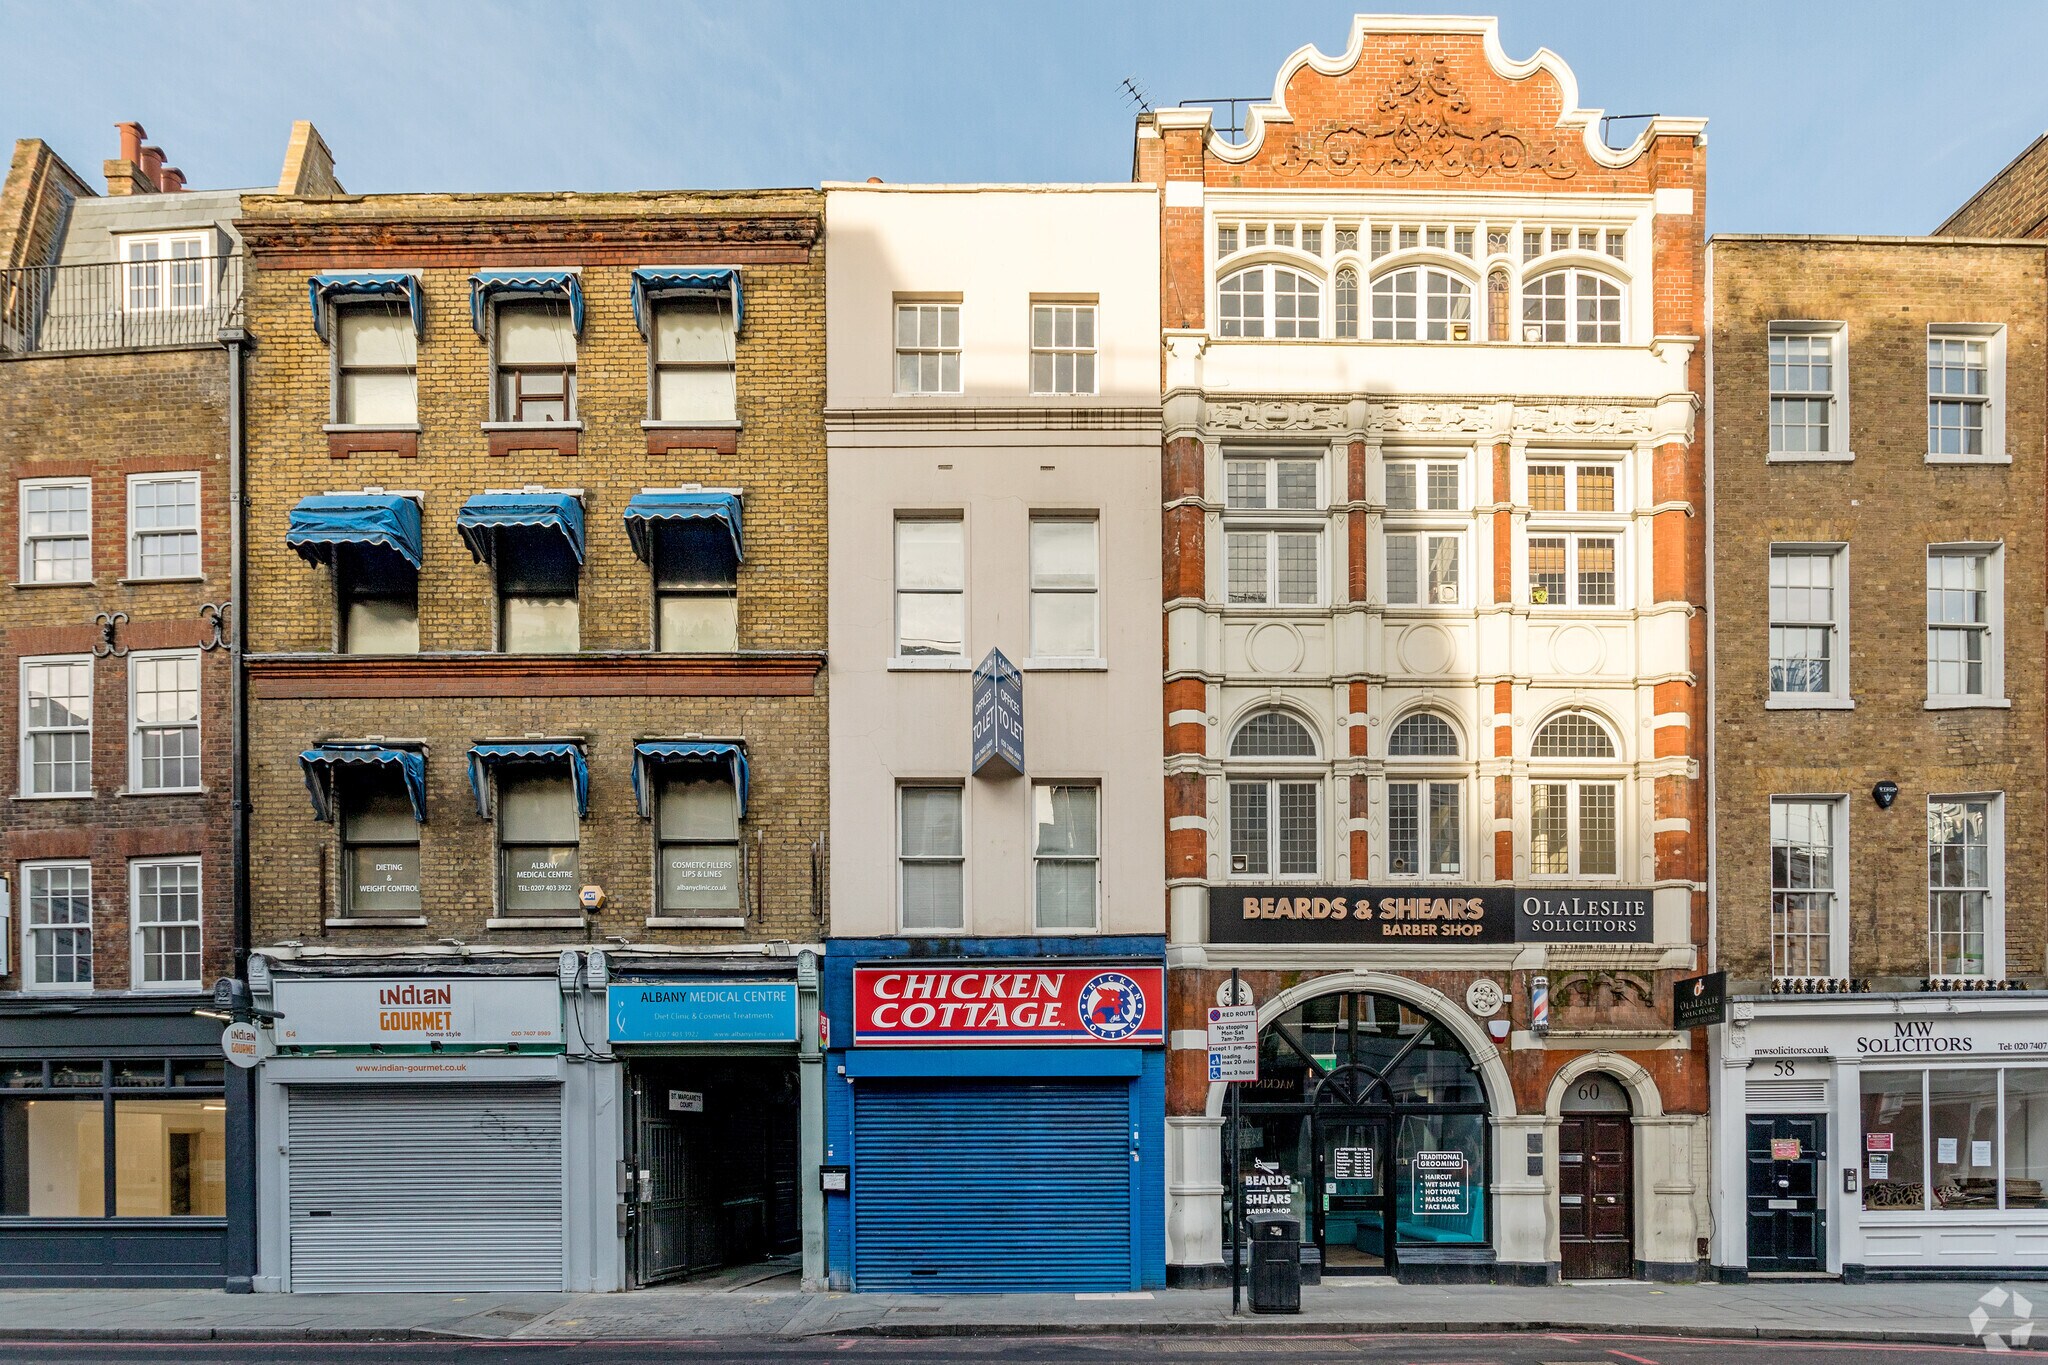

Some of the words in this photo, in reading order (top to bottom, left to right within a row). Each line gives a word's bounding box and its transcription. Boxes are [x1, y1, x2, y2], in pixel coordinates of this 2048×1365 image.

[998, 658, 1021, 687] KALMARS
[975, 688, 992, 716] OFFICES
[1000, 688, 1020, 716] OFFICES
[973, 720, 982, 743] TO
[983, 705, 995, 733] LET
[998, 705, 1010, 730] TO
[1010, 717, 1023, 743] LET
[375, 863, 403, 871] DIETING
[671, 861, 706, 869] COSMETIC
[706, 861, 733, 869] FILLERS
[386, 874, 393, 882] &
[516, 870, 547, 878] MEDICAL
[547, 870, 573, 878] CENTRE
[682, 870, 696, 878] LIPS
[697, 870, 703, 878] &
[703, 870, 723, 878] LINES
[676, 884, 728, 892] albanyclinic.co.uk
[1243, 897, 1348, 920] BEARDS
[1353, 899, 1373, 921] &
[1379, 897, 1485, 921] SHEARS
[1382, 924, 1437, 936] BARBER
[1440, 924, 1483, 936] SHOP
[1531, 919, 1637, 932] SOLICITORS
[873, 974, 1066, 1000] CHICKEN
[1082, 975, 1142, 1000] CHICKEN
[641, 991, 687, 1002] ALBANY
[689, 991, 741, 1002] MEDICAL
[743, 991, 787, 1002] CENTRE
[379, 1011, 452, 1031] GOURMET
[698, 1012, 731, 1020] Cosmetic
[871, 1002, 1063, 1028] COTTAGE
[1083, 1013, 1142, 1038] COTTAGE
[1894, 1021, 1934, 1037] MW
[285, 1030, 296, 1038] 64
[231, 1042, 256, 1055] GOURMET
[1754, 1045, 1829, 1055] mwsolicitors.co.uk
[1856, 1036, 1973, 1053] SOLICITORS
[1998, 1042, 2012, 1050] Tel:
[2029, 1042, 2048, 1050] 7407
[356, 1064, 467, 1073] www.indian-gourmet.co.uk
[1773, 1059, 1795, 1077] 58
[1578, 1083, 1600, 1100] 60
[1245, 1175, 1291, 1186] BEARDS
[1245, 1194, 1291, 1205] SHEARS
